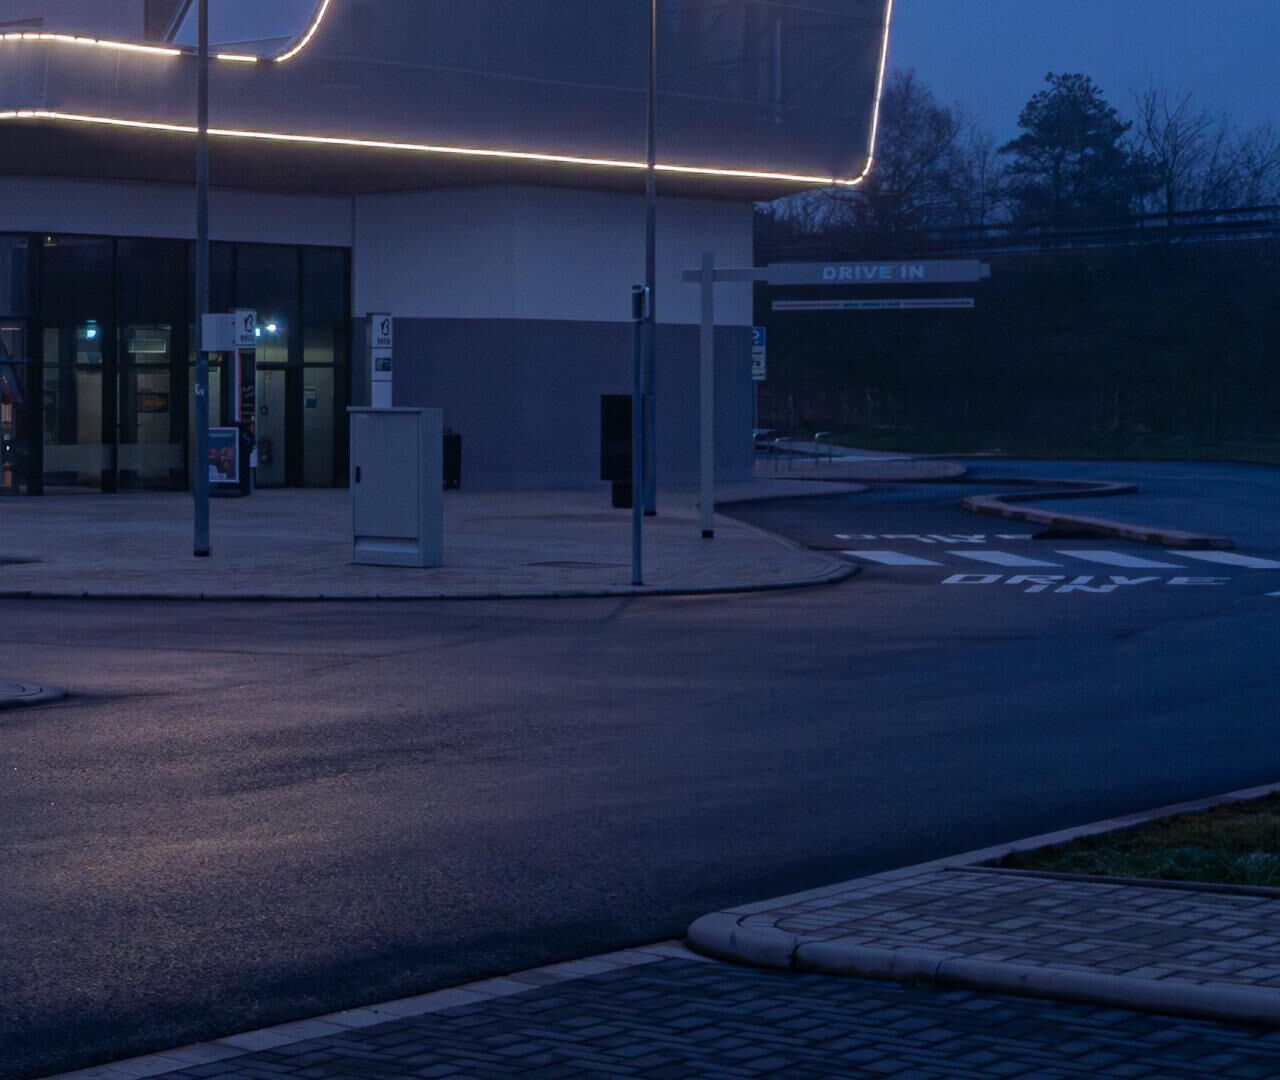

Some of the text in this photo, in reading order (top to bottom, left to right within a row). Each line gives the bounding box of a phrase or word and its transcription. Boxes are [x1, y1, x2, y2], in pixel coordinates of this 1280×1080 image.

[823, 264, 925, 280] DRIVE IN
[940, 573, 1232, 586] DRIVE
[1023, 584, 1118, 593] IN
